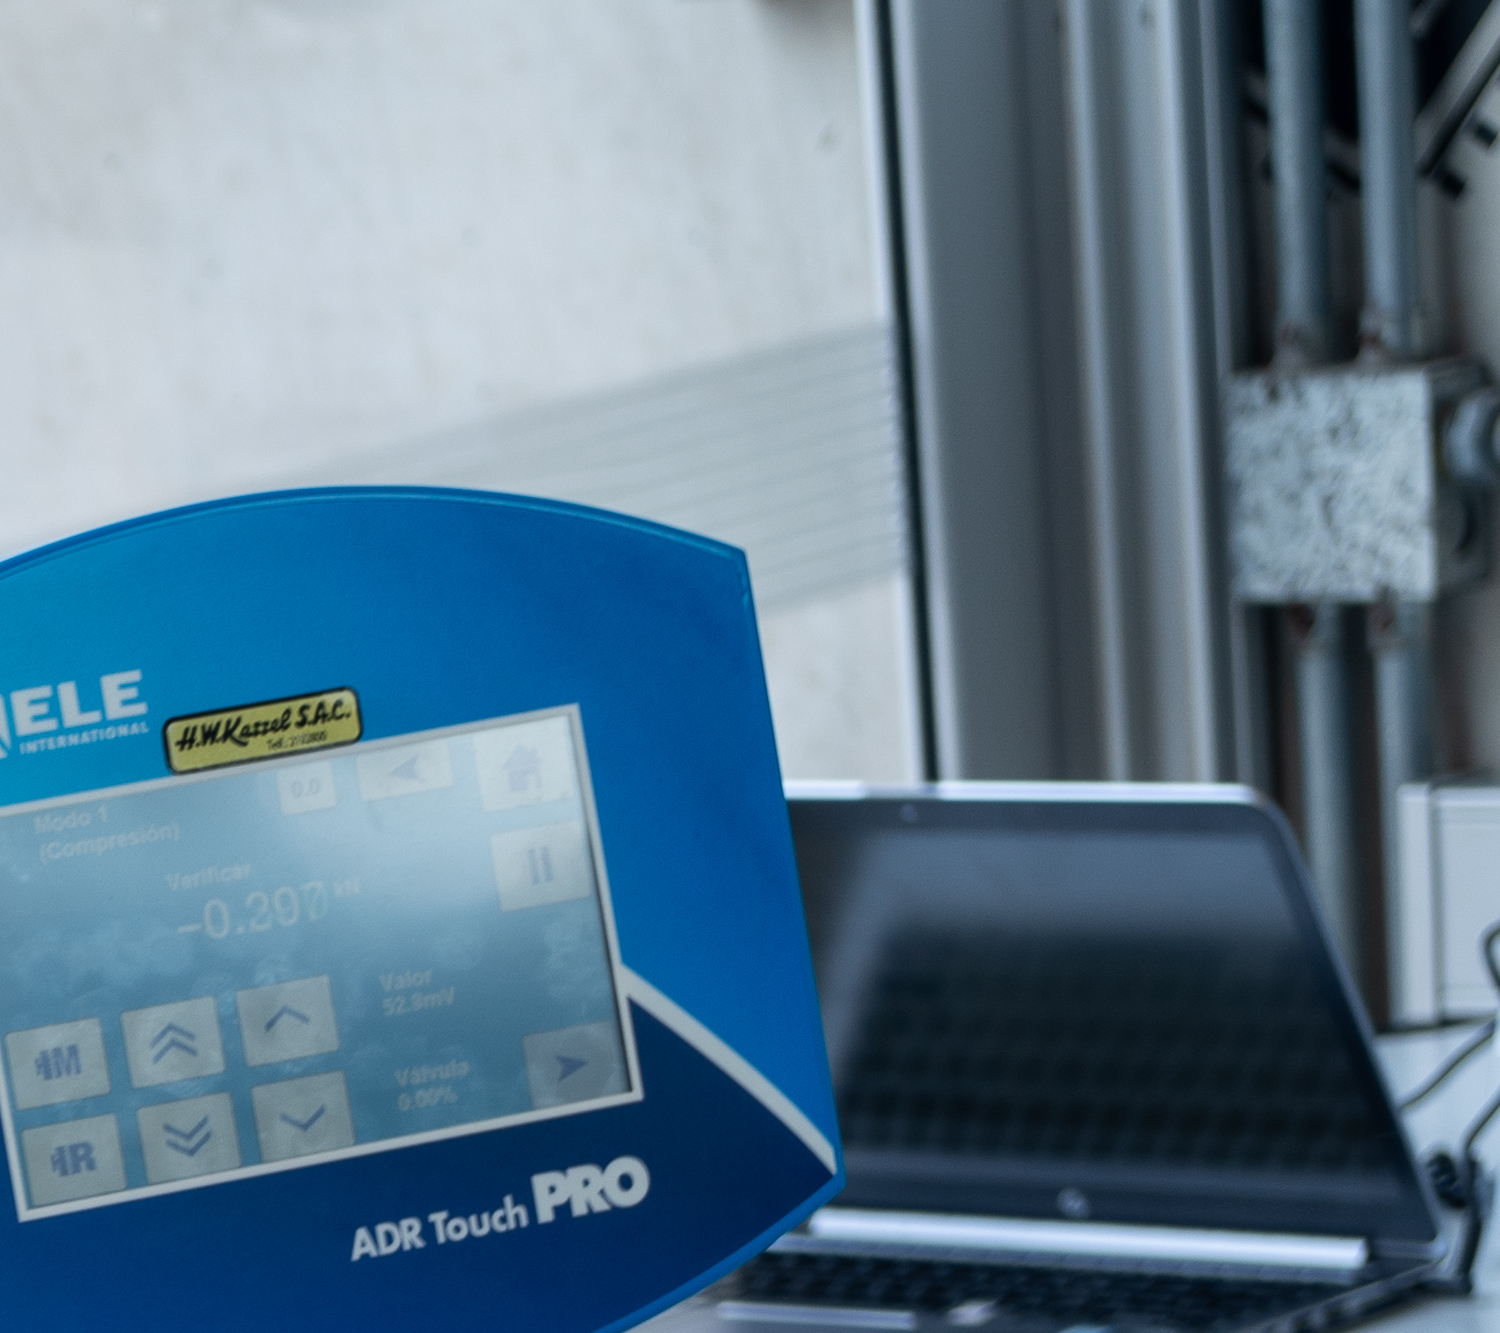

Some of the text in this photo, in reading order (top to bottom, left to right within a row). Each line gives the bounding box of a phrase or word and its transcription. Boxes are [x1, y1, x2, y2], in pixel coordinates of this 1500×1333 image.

[9, 668, 148, 738] ELE
[18, 721, 150, 755] INTERNATIONAL
[34, 804, 108, 835] Modo 1
[39, 820, 181, 865] (Compresión)
[164, 863, 252, 893] Verificar
[349, 1155, 651, 1262] ADR Touch PRO
